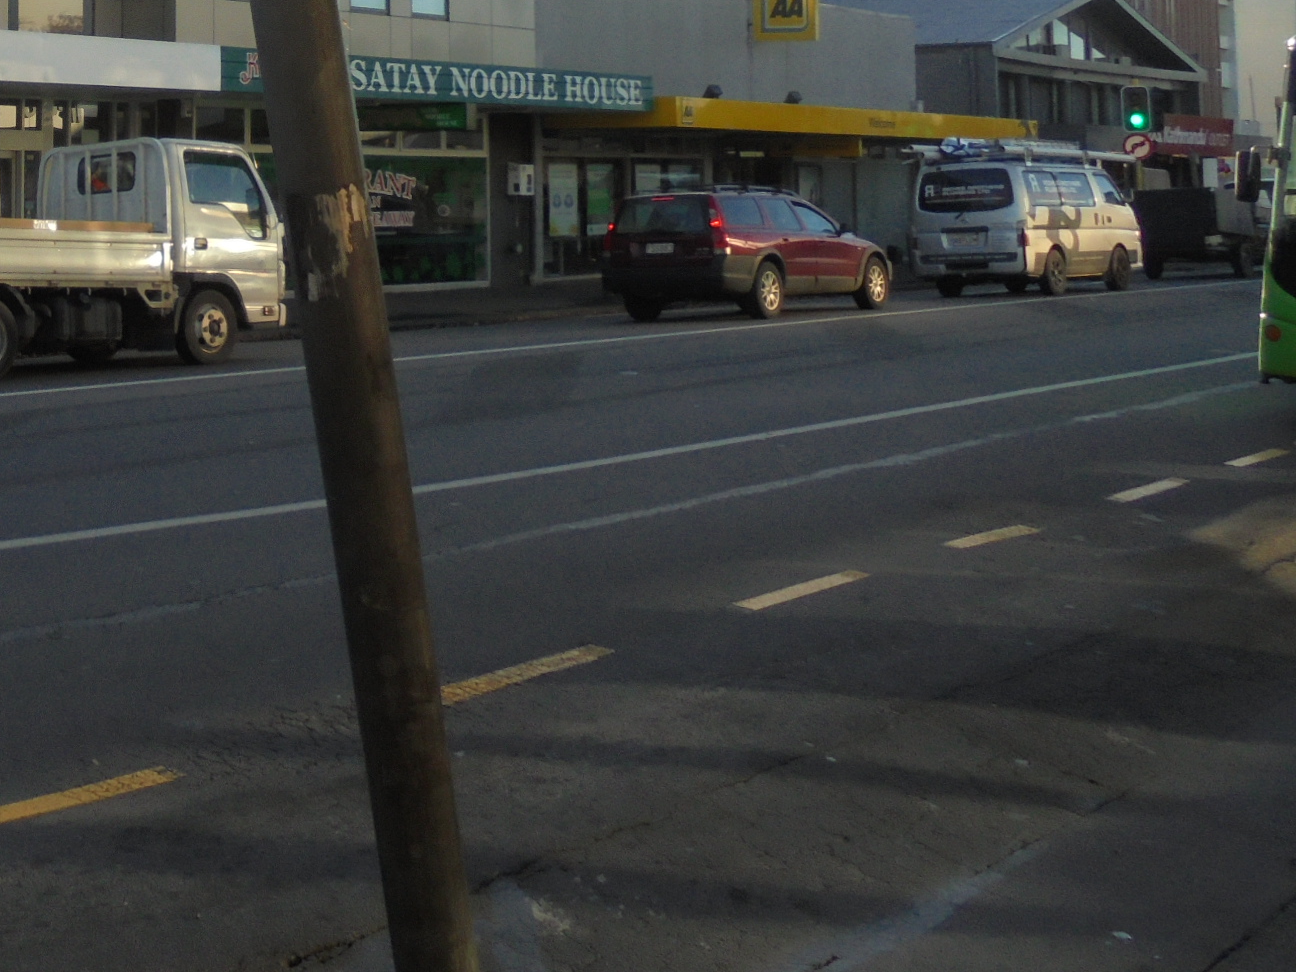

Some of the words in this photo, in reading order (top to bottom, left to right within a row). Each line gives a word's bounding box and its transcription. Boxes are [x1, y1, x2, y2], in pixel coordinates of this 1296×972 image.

[349, 59, 442, 96] SATAY
[449, 66, 558, 101] NOODLE
[564, 75, 643, 105] HOUSE
